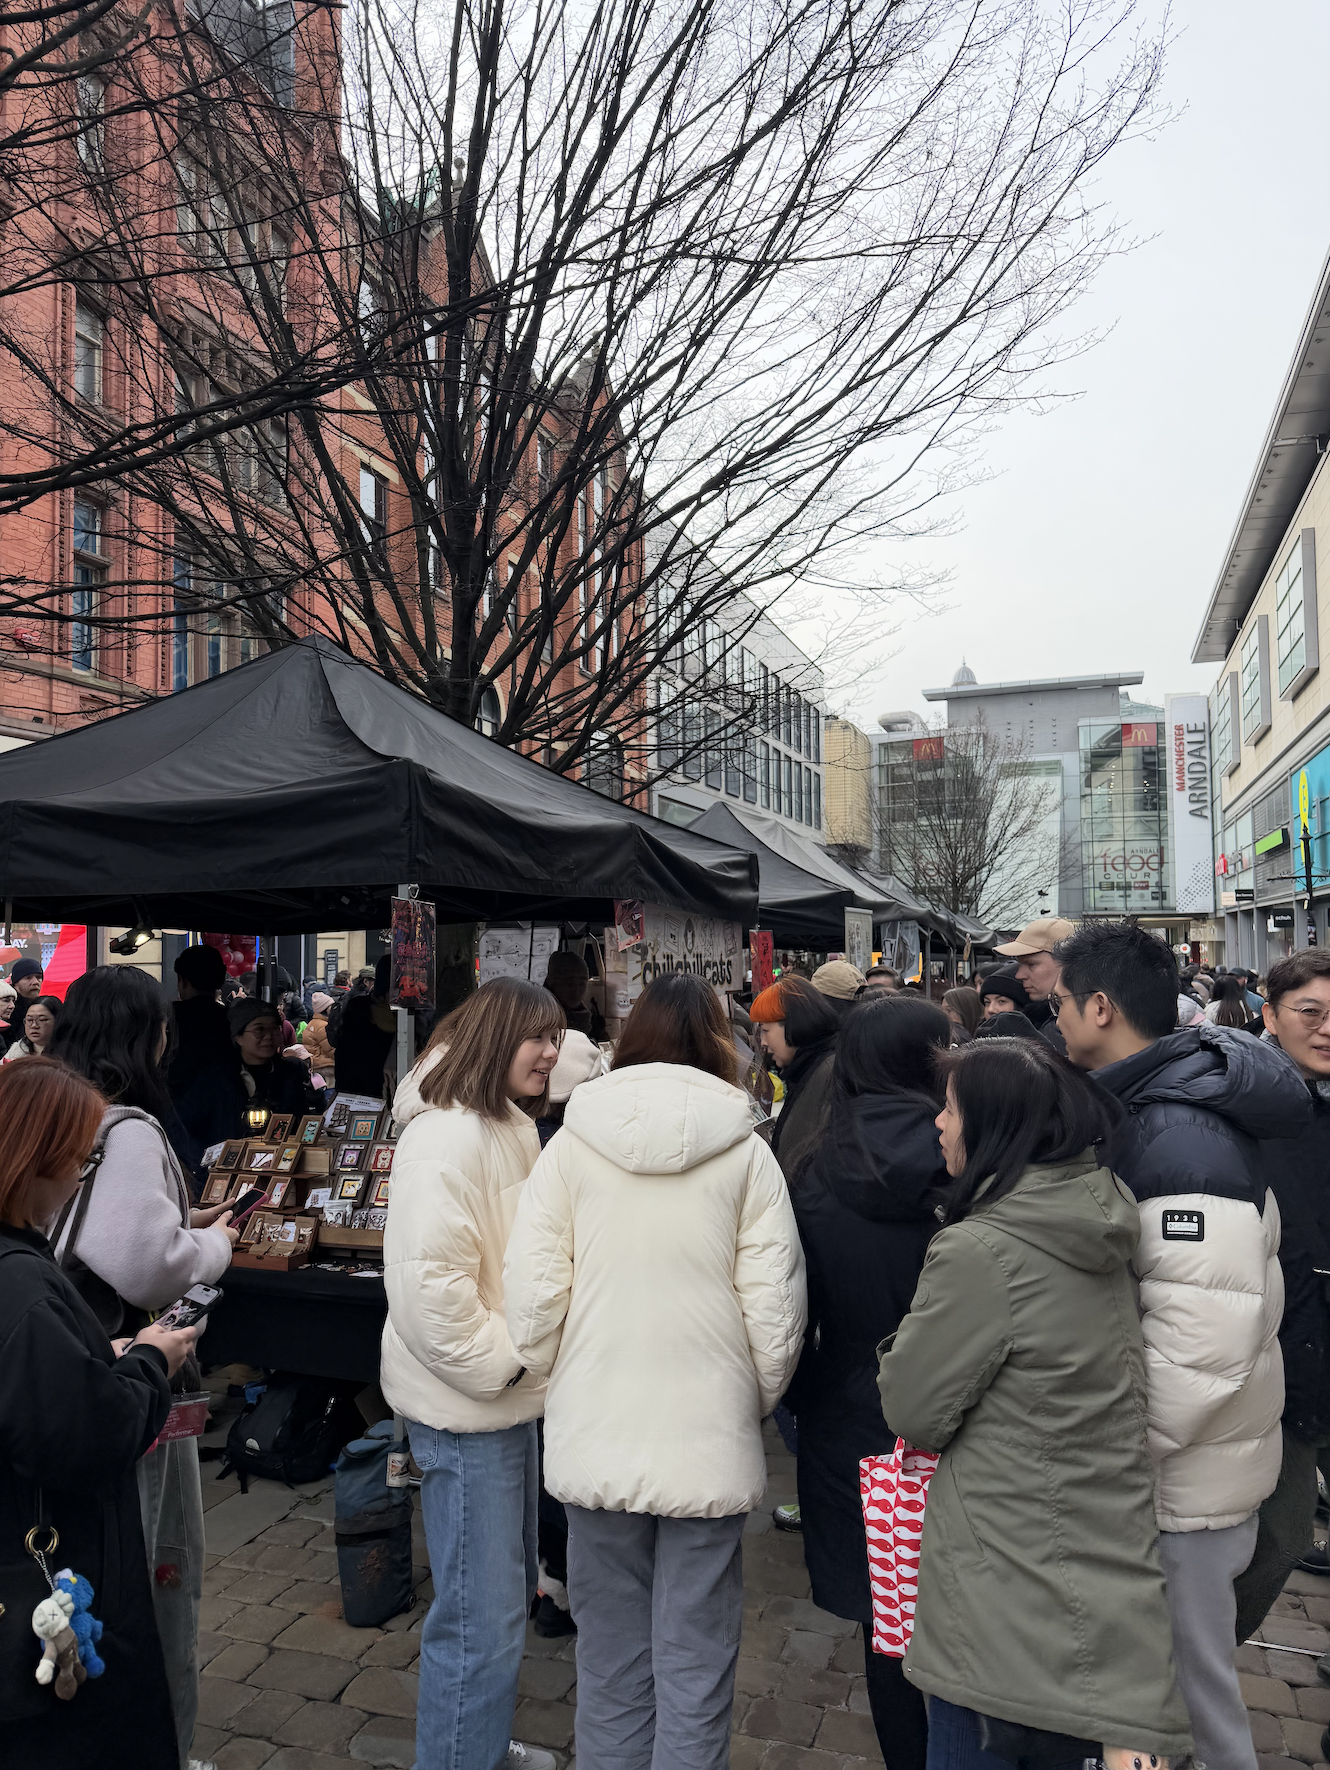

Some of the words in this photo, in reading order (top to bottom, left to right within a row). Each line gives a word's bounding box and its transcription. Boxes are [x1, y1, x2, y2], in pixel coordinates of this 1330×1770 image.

[1174, 724, 1185, 792] MANCHESTER
[1187, 722, 1208, 819] ARNDALE
[1100, 845, 1165, 873] food
